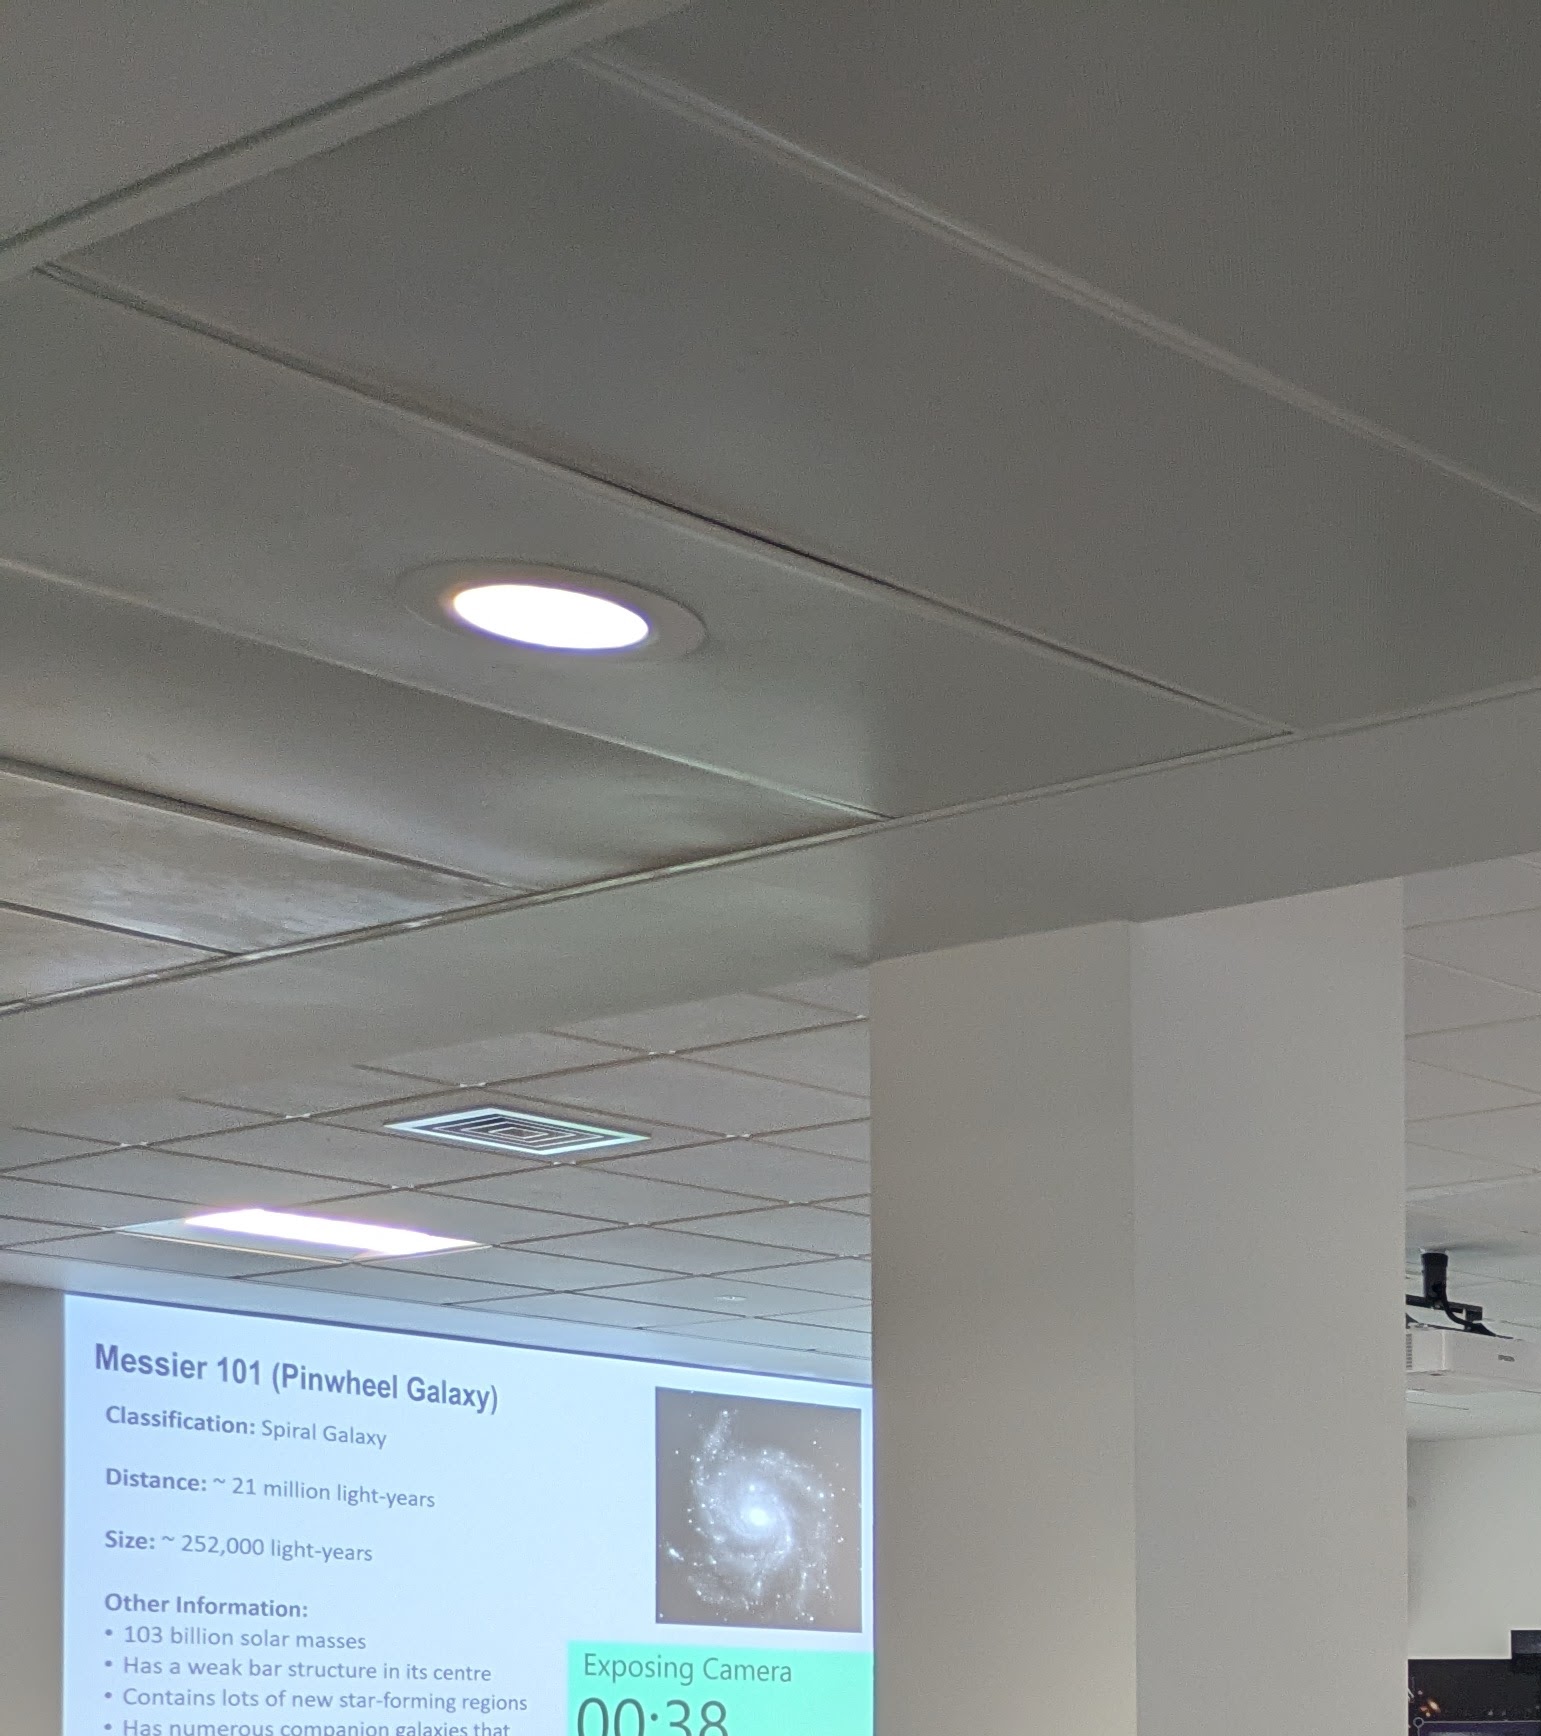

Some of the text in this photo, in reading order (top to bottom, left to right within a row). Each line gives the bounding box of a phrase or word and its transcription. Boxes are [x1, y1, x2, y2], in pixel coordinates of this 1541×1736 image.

[95, 1344, 498, 1415] Messier 101 (Pinwheel Galaxy)
[106, 1406, 387, 1449] Classification: Spiral Galaxy
[106, 1468, 207, 1491] Distance:
[232, 1478, 256, 1496] 21
[264, 1482, 330, 1500] million
[338, 1485, 435, 1508] light-years
[105, 1530, 155, 1549] Size:
[182, 1536, 264, 1557] 252,000
[271, 1539, 373, 1562] light-years
[105, 1593, 308, 1618] Other Information:
[124, 1627, 366, 1649] 103 billion solar masses
[123, 1658, 491, 1682] Has a weak bar structure in its centre
[584, 1653, 792, 1686] Exposing Camera
[123, 1689, 527, 1713] Contains lots of new star-forming regions
[123, 1720, 162, 1736] Has
